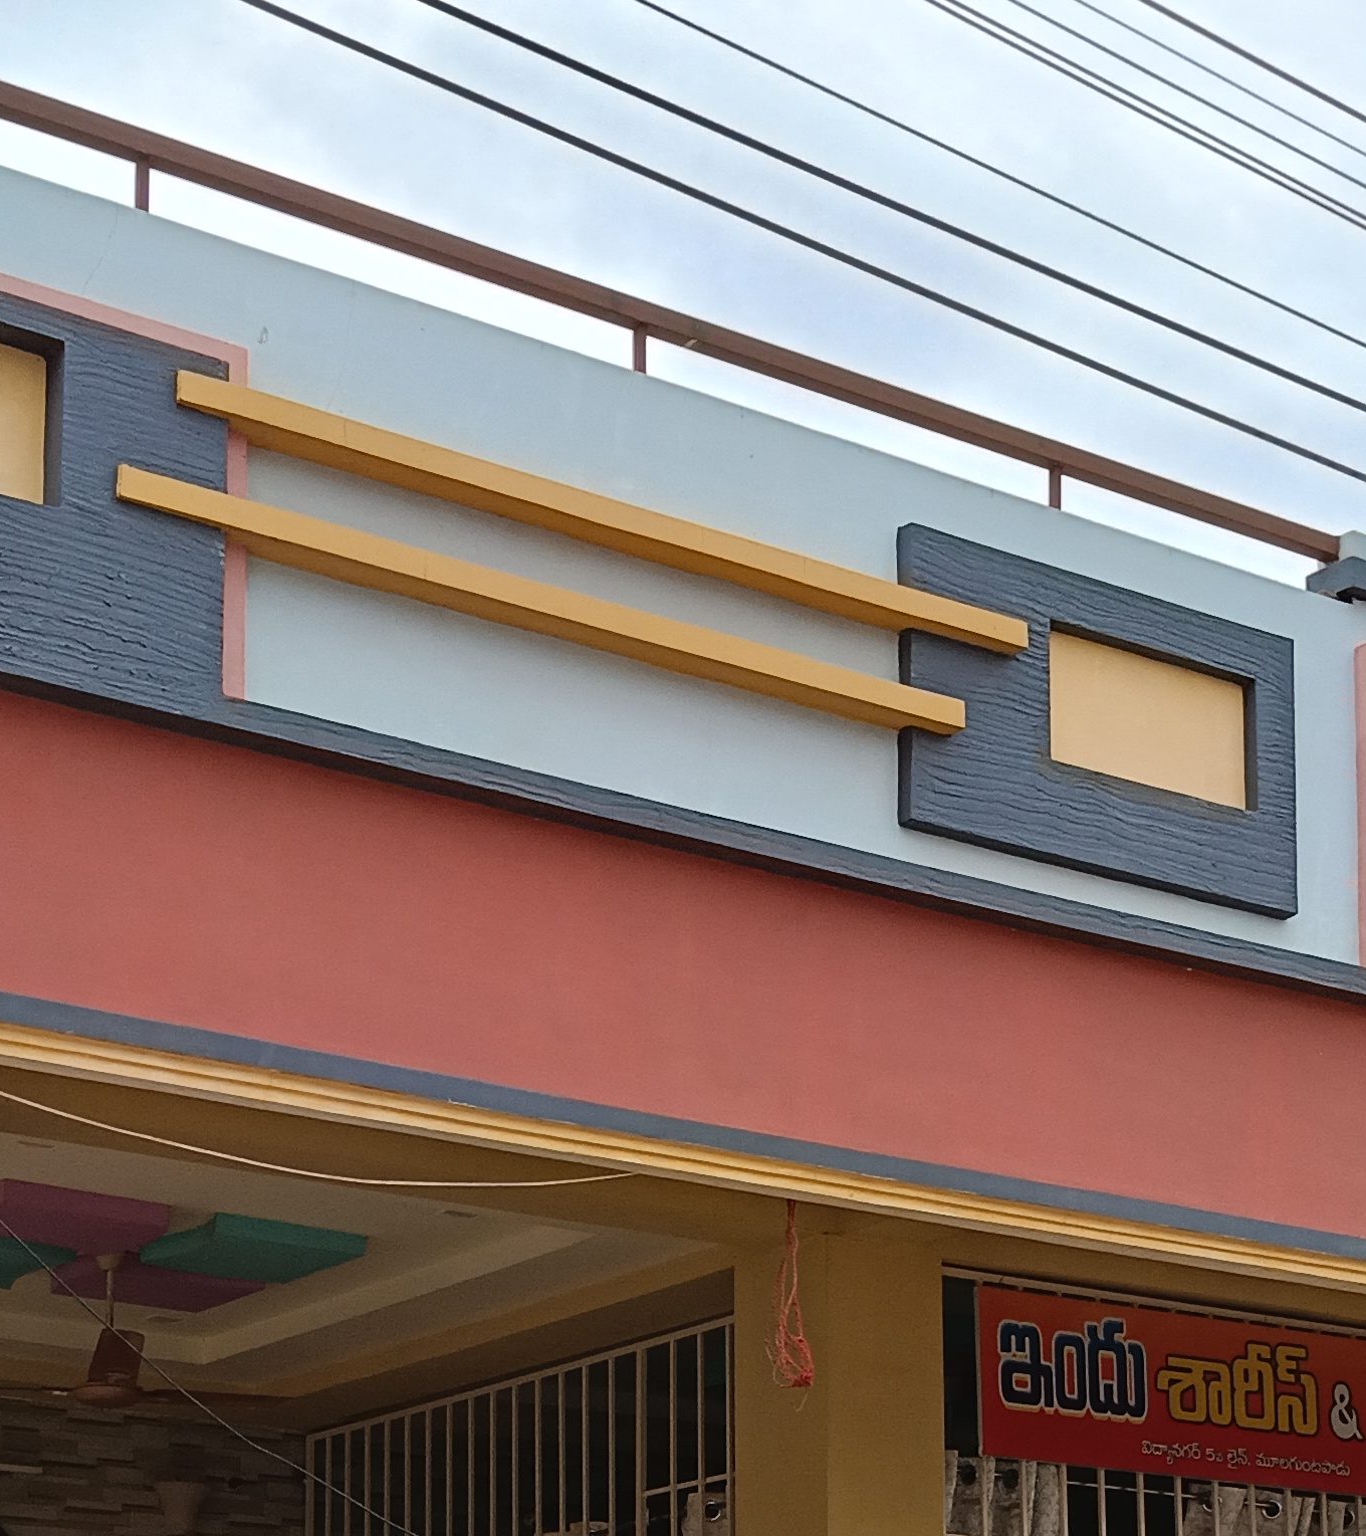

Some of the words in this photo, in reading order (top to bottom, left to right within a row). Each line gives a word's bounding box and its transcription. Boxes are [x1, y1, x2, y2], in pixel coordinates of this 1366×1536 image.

[998, 1317, 1148, 1424] ఇందు
[1157, 1343, 1319, 1437] శారీస్
[1330, 1383, 1365, 1441] &
[1141, 1440, 1201, 1465] విద్యానగర్
